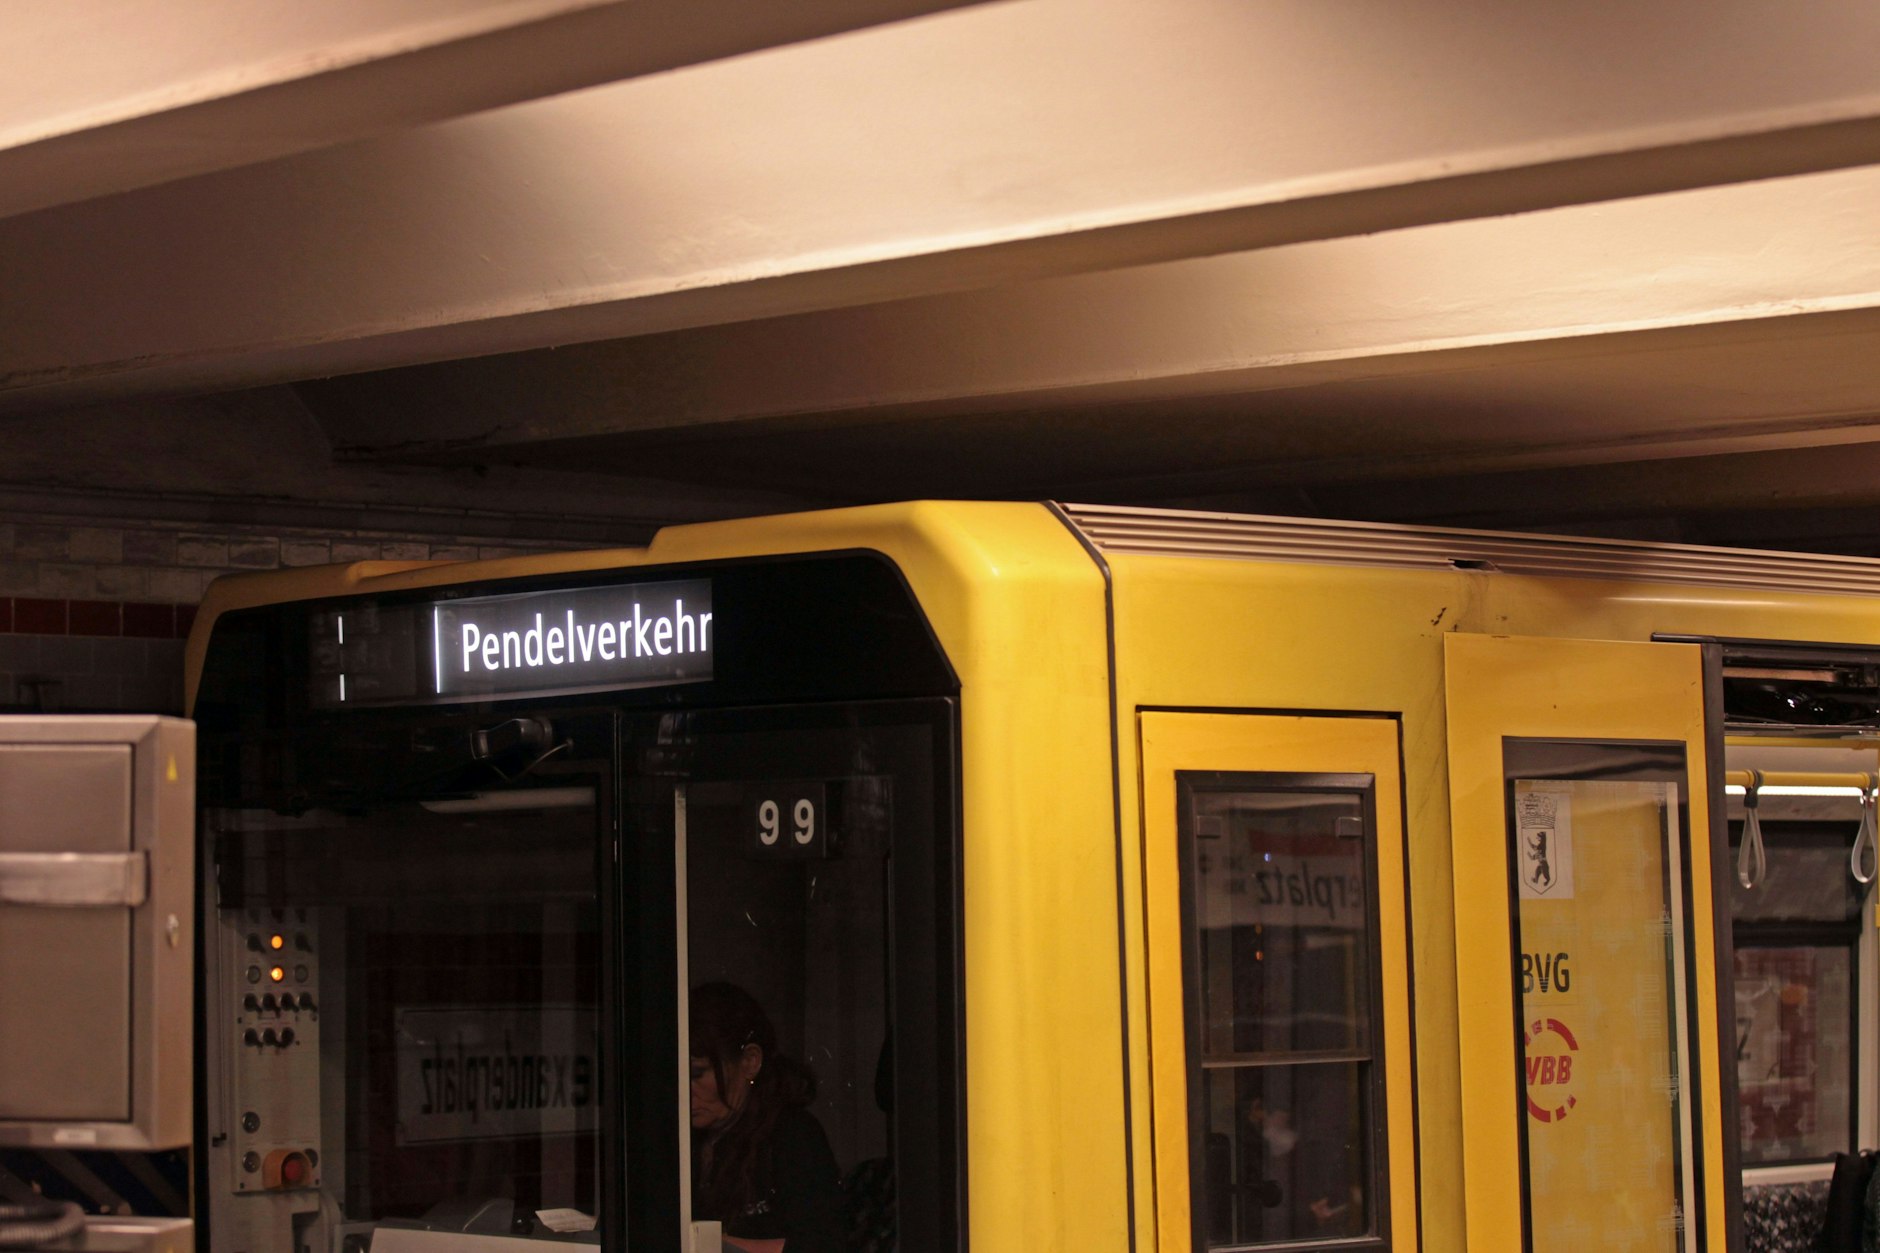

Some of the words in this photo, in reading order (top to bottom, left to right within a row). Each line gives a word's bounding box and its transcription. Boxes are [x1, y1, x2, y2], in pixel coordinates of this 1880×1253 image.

[462, 599, 712, 672] Pendelverkehr
[1521, 952, 1570, 993] BVG
[1525, 1055, 1572, 1085] VBB
